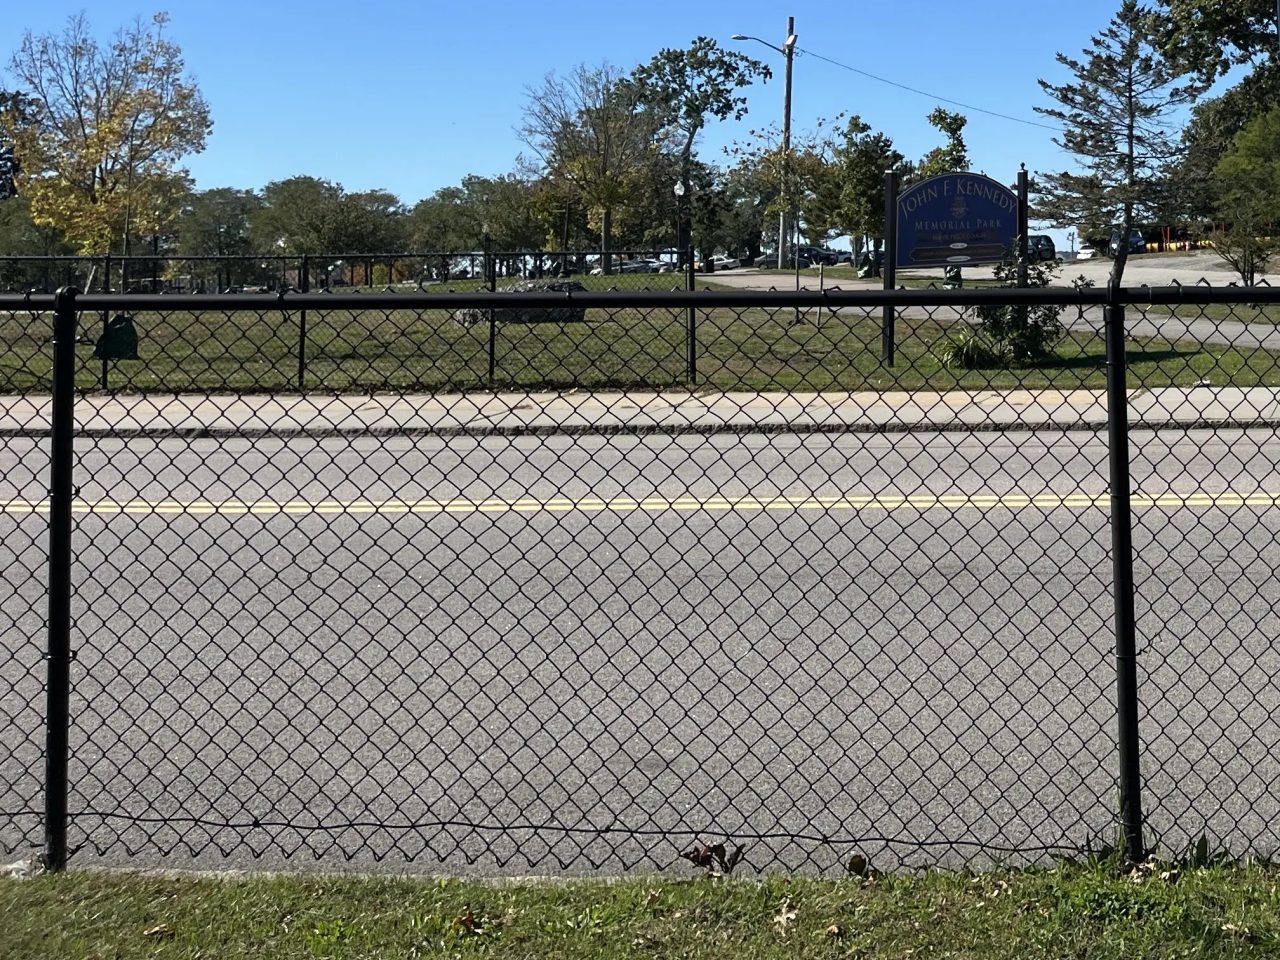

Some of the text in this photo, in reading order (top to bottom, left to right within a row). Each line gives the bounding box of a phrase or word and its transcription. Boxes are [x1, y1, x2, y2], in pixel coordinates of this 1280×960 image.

[900, 178, 1017, 219] JOHN F. KENNEDY
[914, 218, 1001, 231] MEMORIAL PARK
